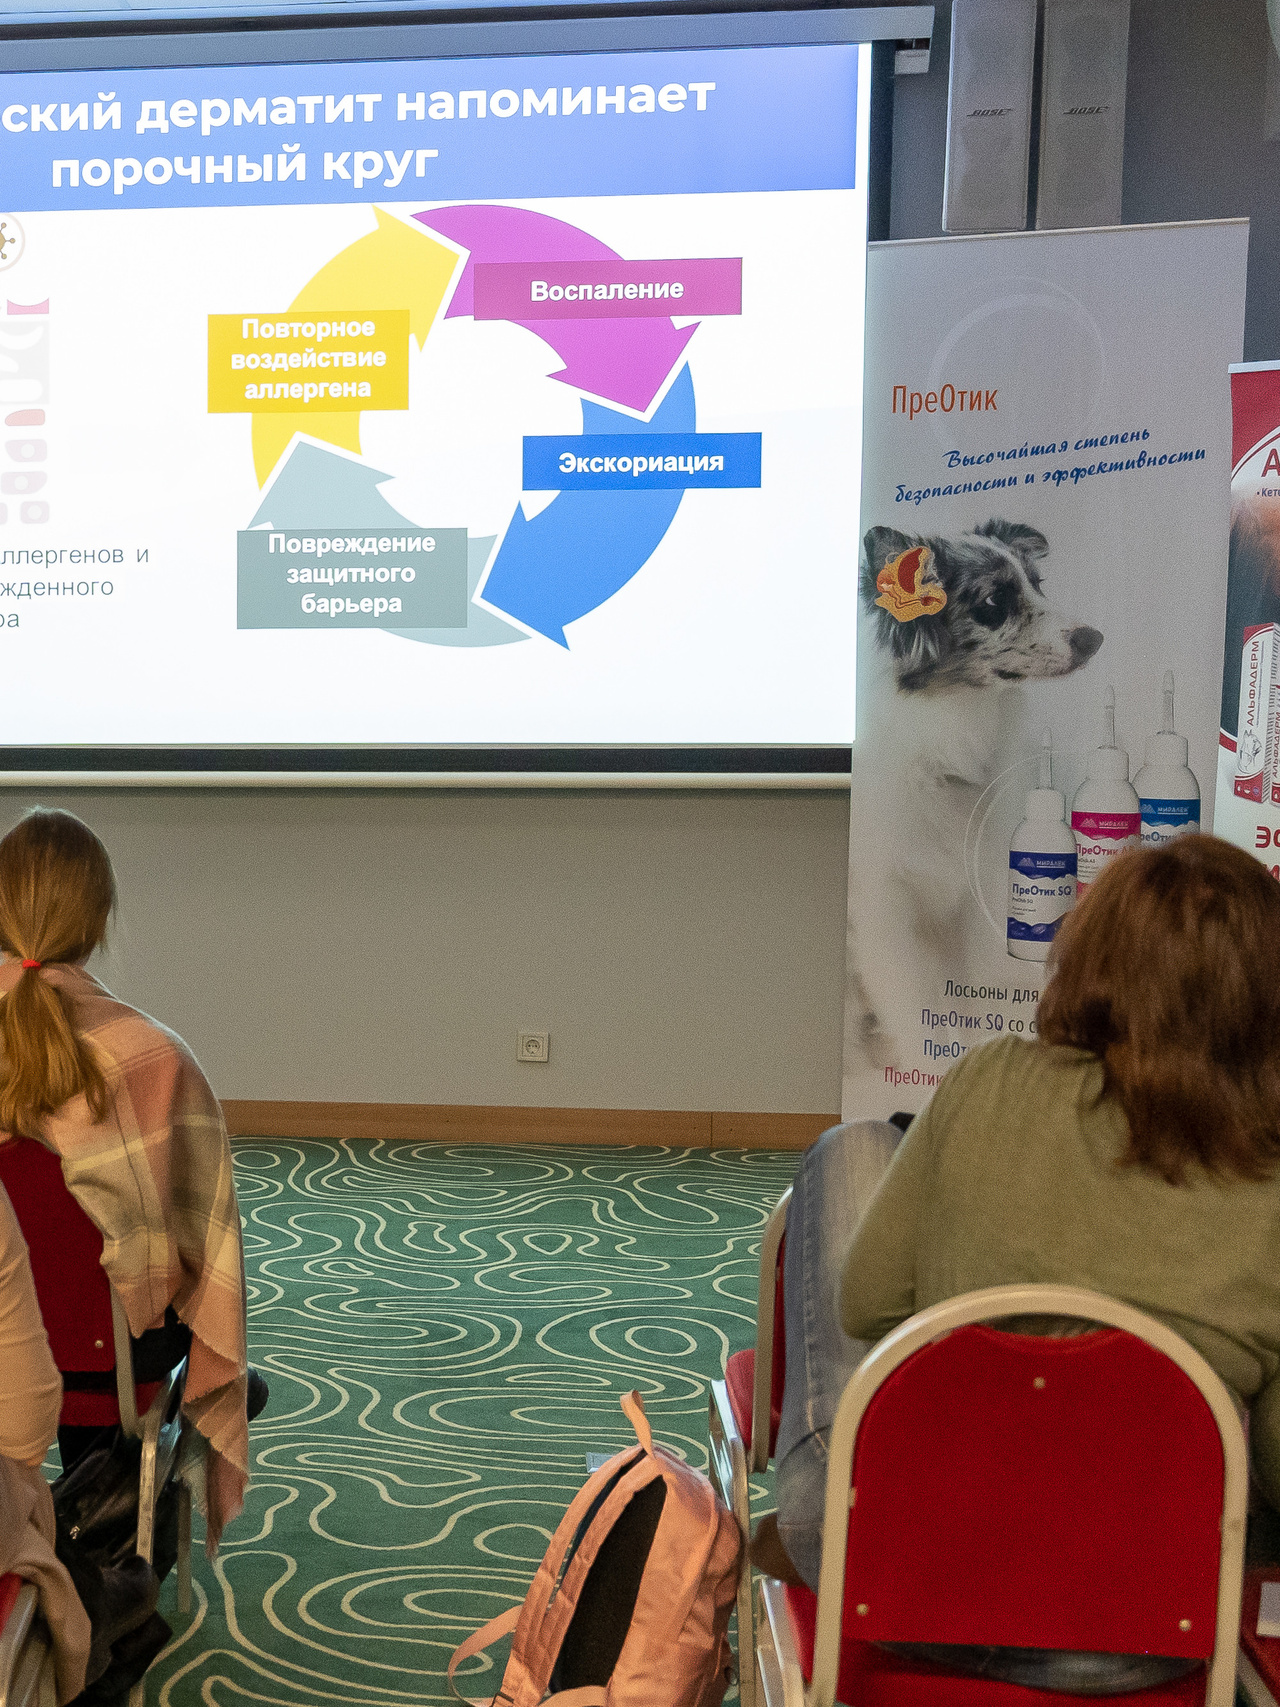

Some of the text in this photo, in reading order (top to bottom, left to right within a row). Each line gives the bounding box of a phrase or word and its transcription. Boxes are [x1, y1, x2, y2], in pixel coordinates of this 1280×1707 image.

[136, 93, 383, 137] дерматит
[398, 80, 717, 121] напоминает
[51, 143, 439, 195] порочный круг
[530, 278, 685, 302] Воспаление
[242, 318, 376, 343] Повторное
[231, 347, 387, 373] воздействие
[244, 379, 372, 404] аллергена
[891, 383, 999, 421] ПреОтик
[942, 427, 1151, 469] Высочайшая степень
[558, 451, 725, 478] Экскориация
[895, 447, 1206, 506] безопасности и эффективности
[136, 547, 149, 564] и
[268, 533, 436, 559] Повреждение
[286, 564, 417, 588] защитного
[300, 593, 403, 617] барьера
[1247, 640, 1260, 727] АЛЬФАДЕРМ
[1012, 883, 1072, 897] ПреОтик SQ
[944, 980, 1040, 1004] Лосьоны для
[921, 1008, 982, 1030] ПреОтик
[986, 1013, 1004, 1031] SQ
[1009, 1019, 1024, 1033] со
[923, 1039, 967, 1061] ПреОт
